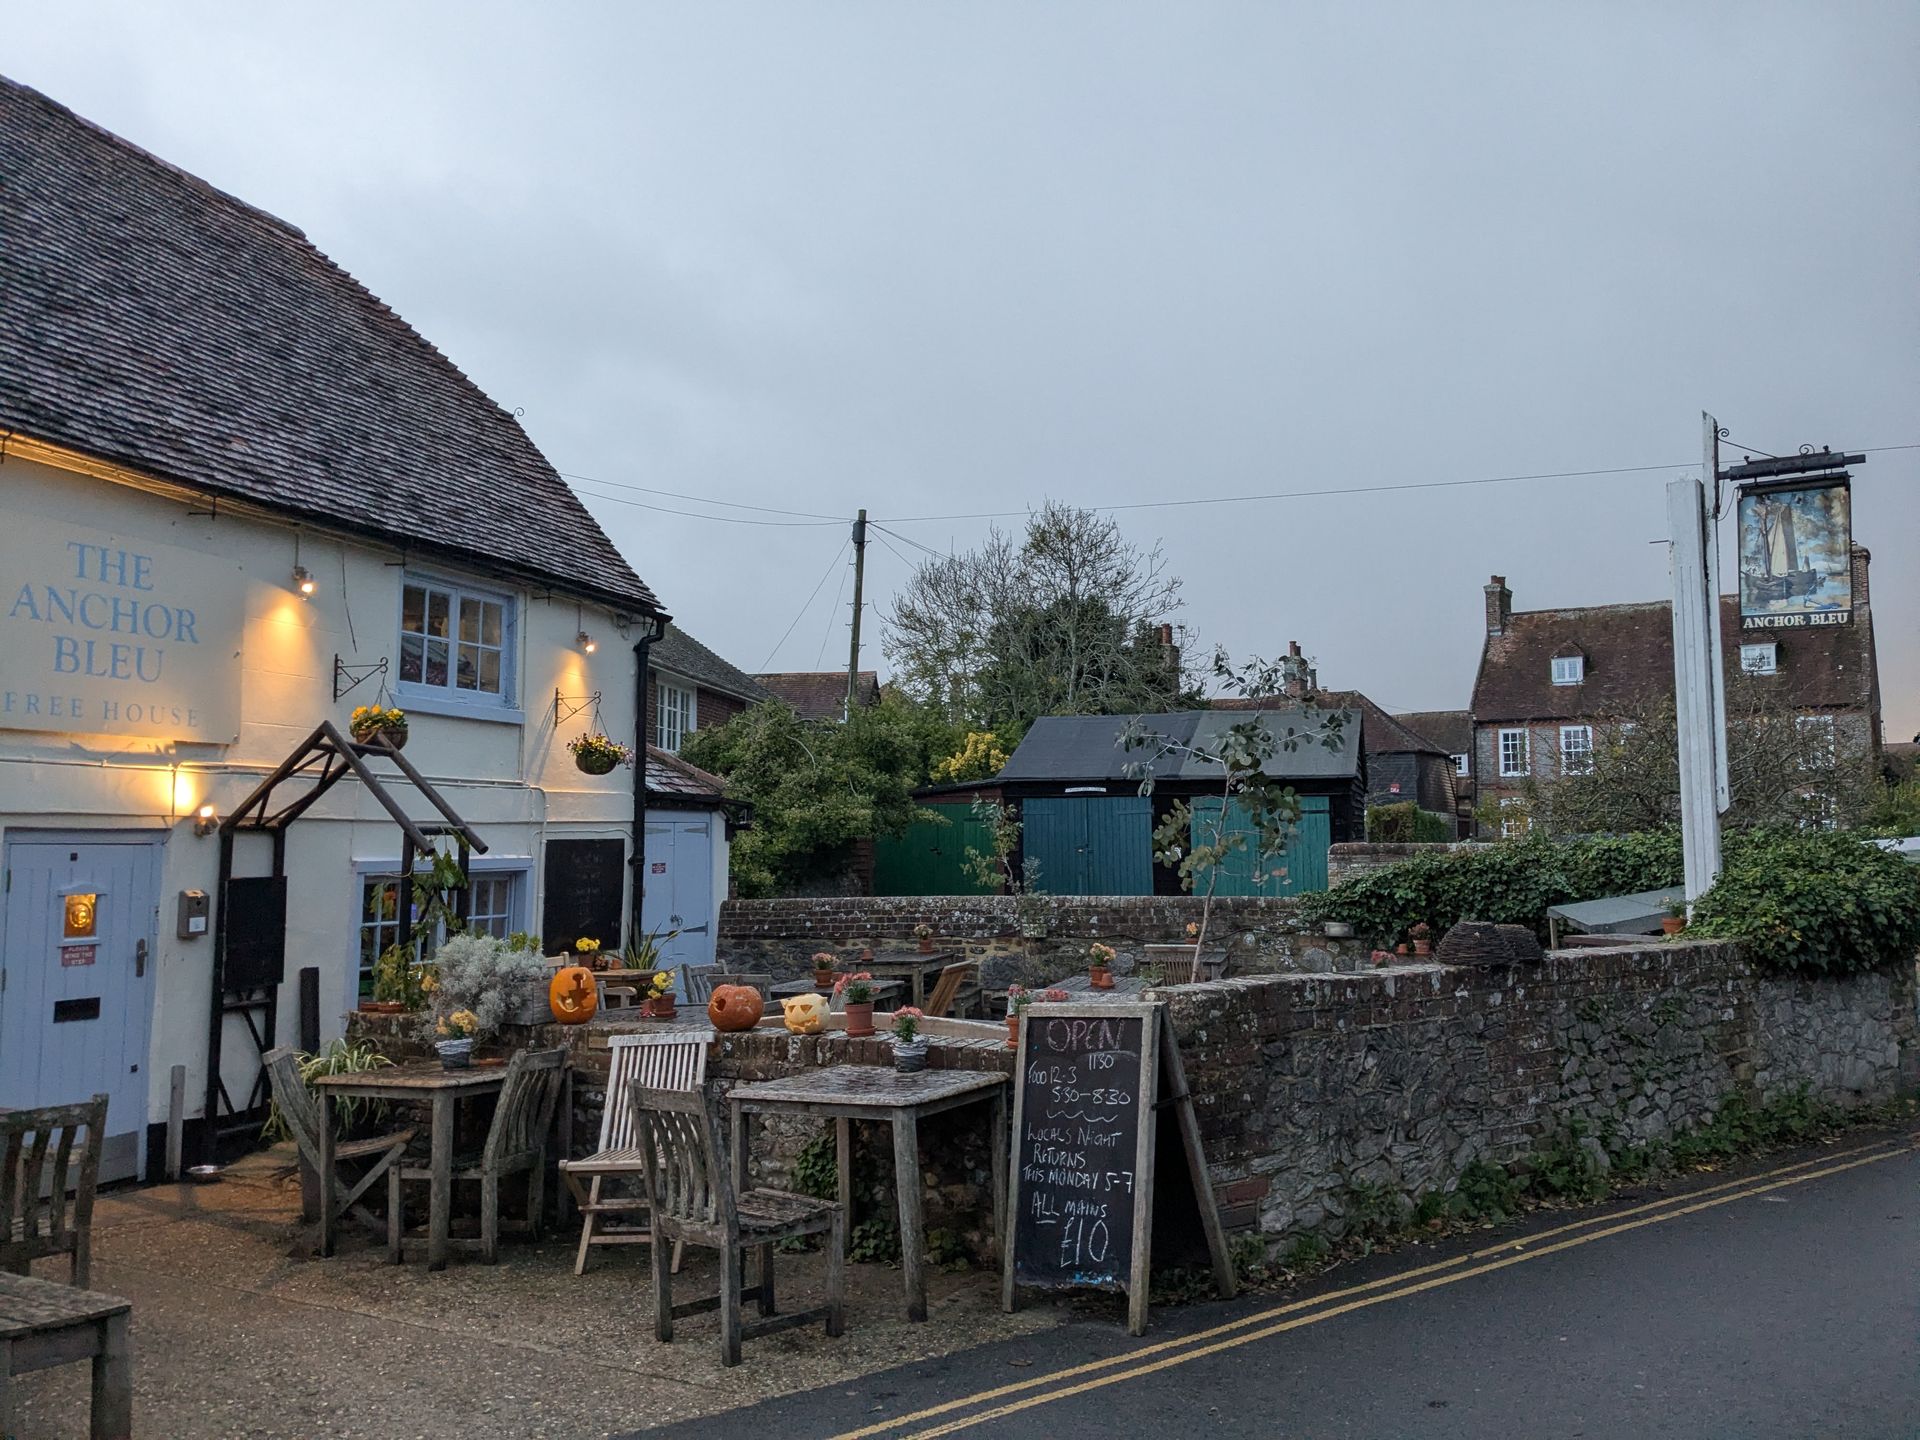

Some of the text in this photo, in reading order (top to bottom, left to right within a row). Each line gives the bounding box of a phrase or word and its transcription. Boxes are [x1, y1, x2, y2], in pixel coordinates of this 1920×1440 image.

[67, 541, 154, 591] THE
[9, 583, 199, 644] ANCHOR
[1743, 612, 1848, 629] ANCHOR BLEU
[52, 635, 163, 683] BLEU
[4, 691, 199, 728] FREE HOUSE
[1047, 1019, 1125, 1051] OPEN
[1031, 1191, 1060, 1217] ALL
[1060, 1216, 1109, 1268] £10
